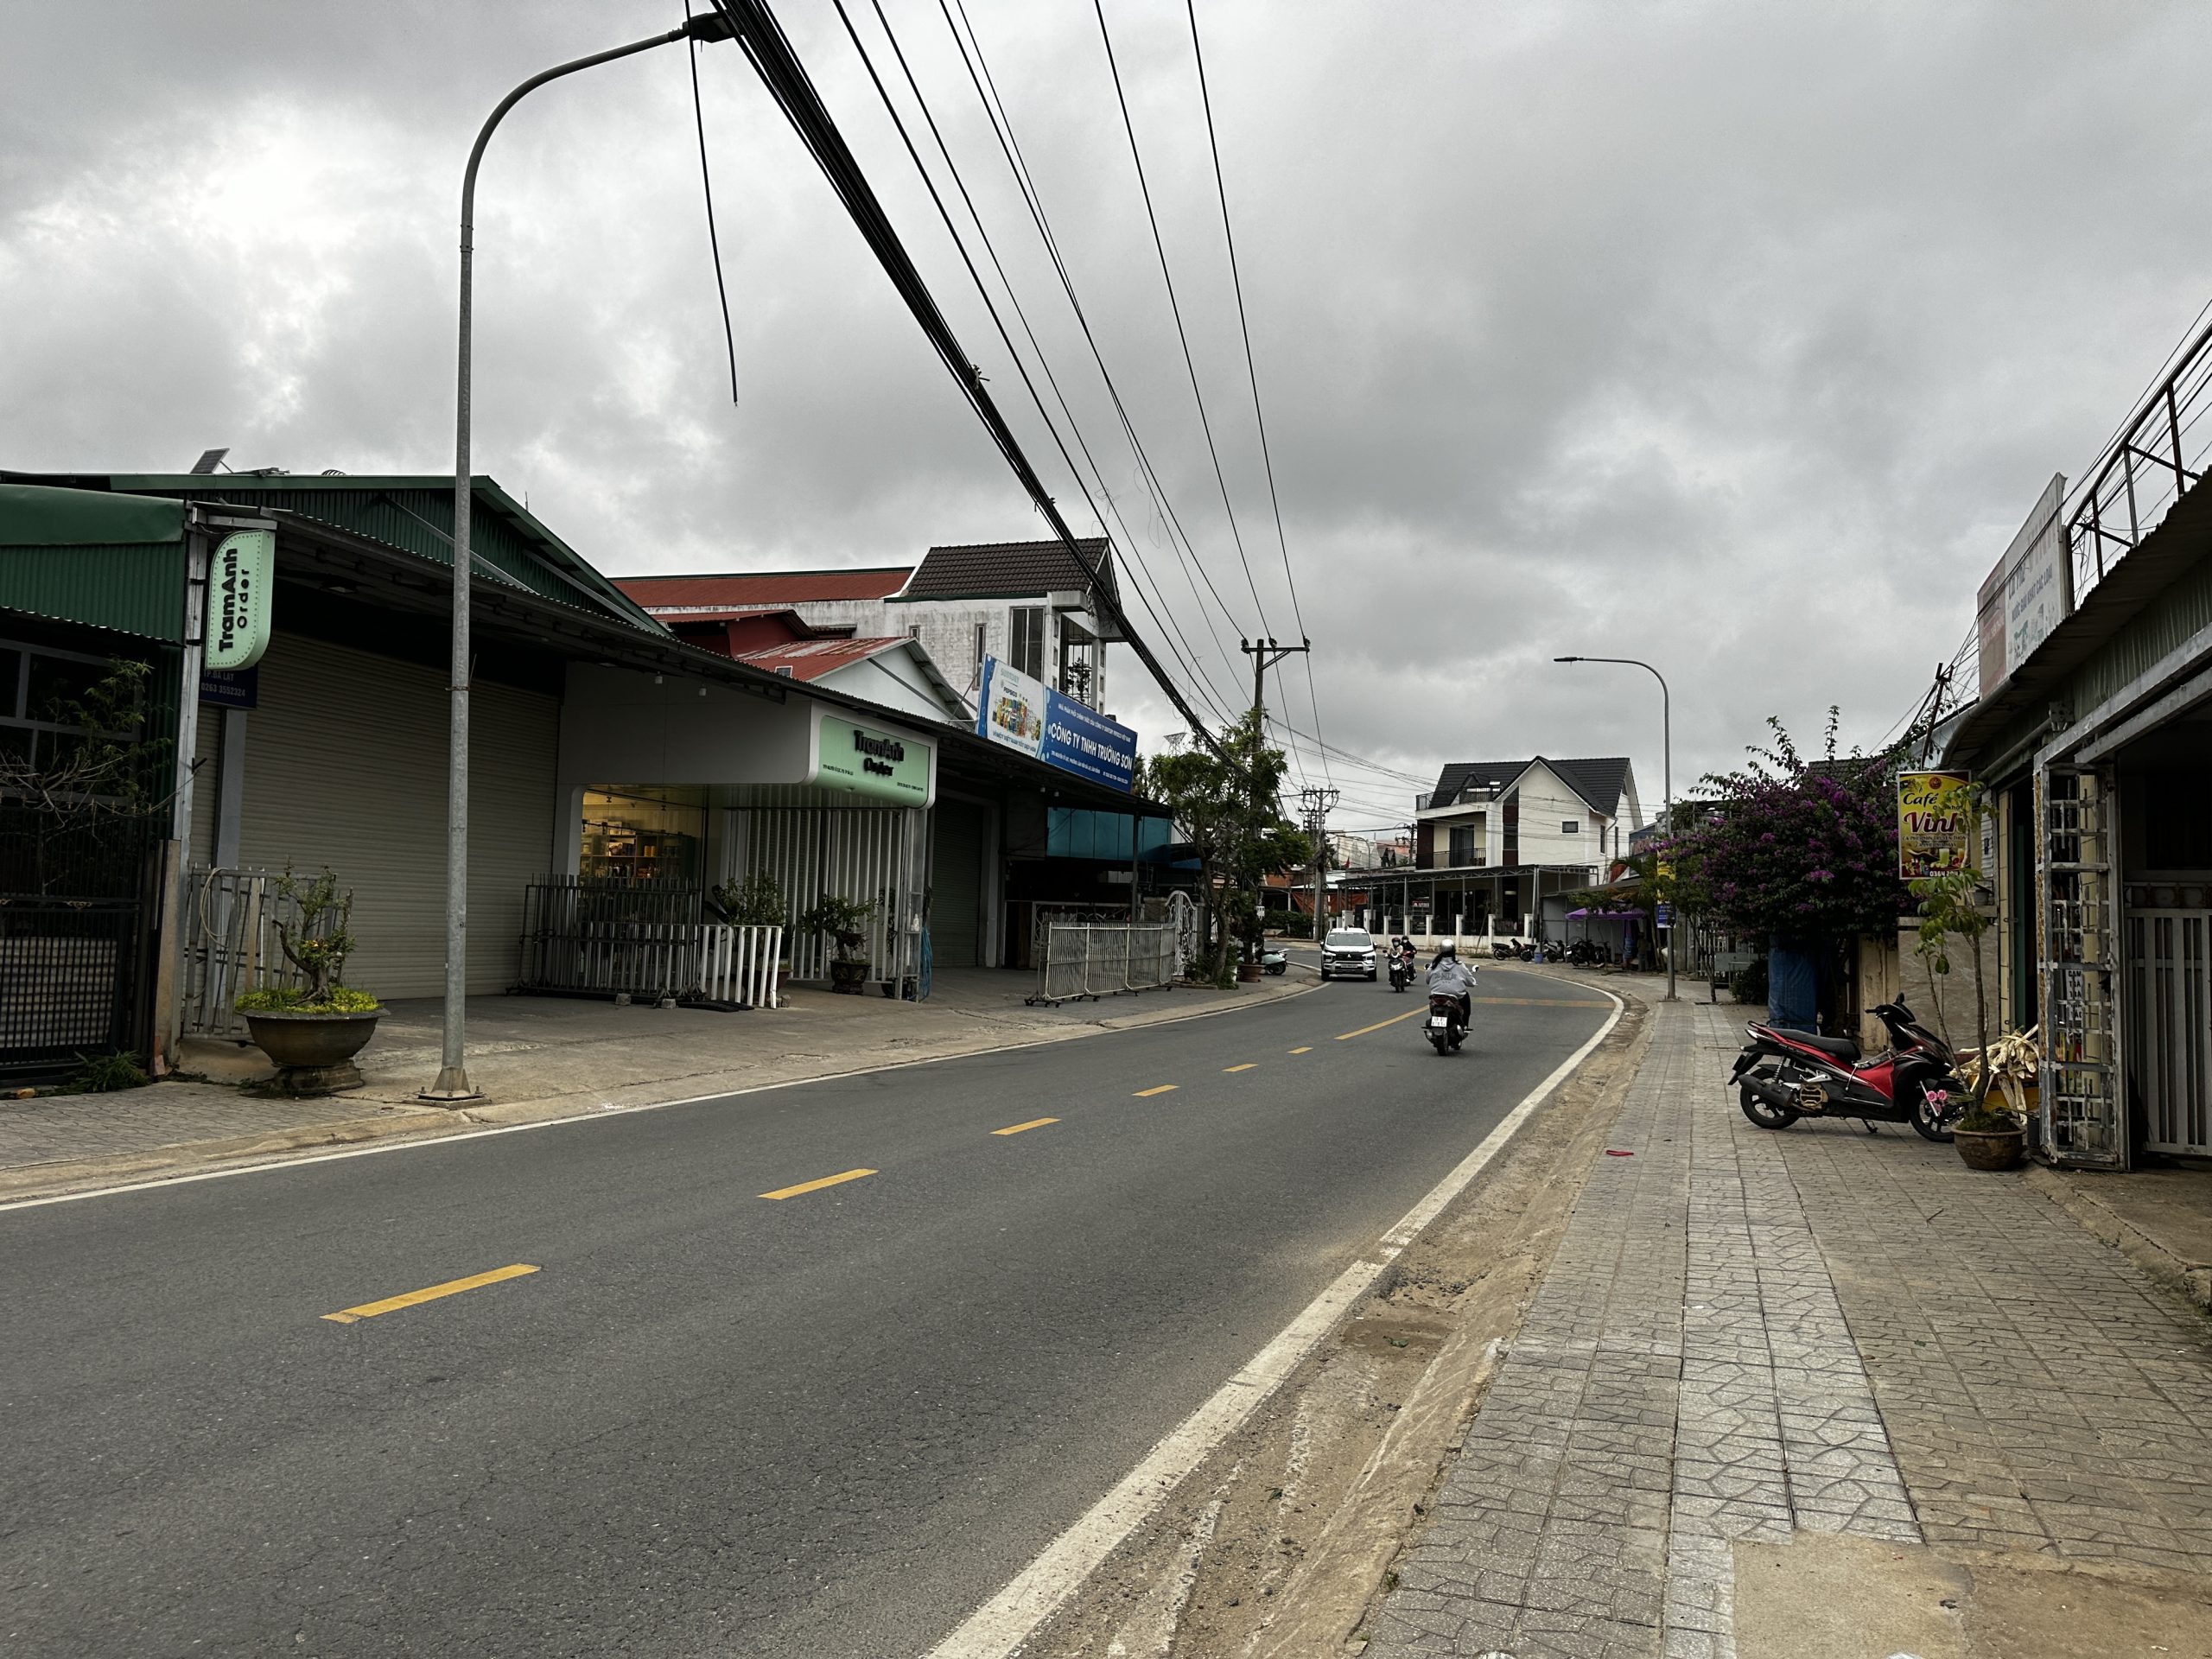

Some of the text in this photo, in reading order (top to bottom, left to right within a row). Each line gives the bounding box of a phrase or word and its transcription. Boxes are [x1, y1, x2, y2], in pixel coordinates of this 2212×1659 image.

[219, 548, 238, 652] TramAnh
[237, 569, 250, 629] Order
[200, 683, 218, 693] 0263
[854, 729, 904, 762] TramAnh
[1051, 721, 1071, 746] CÔNG
[1072, 733, 1080, 749] TY
[1081, 736, 1097, 757] TNHH
[1097, 744, 1121, 766] TRƯỜNG
[1121, 753, 1133, 771] SƠN
[1903, 792, 1939, 808] Café
